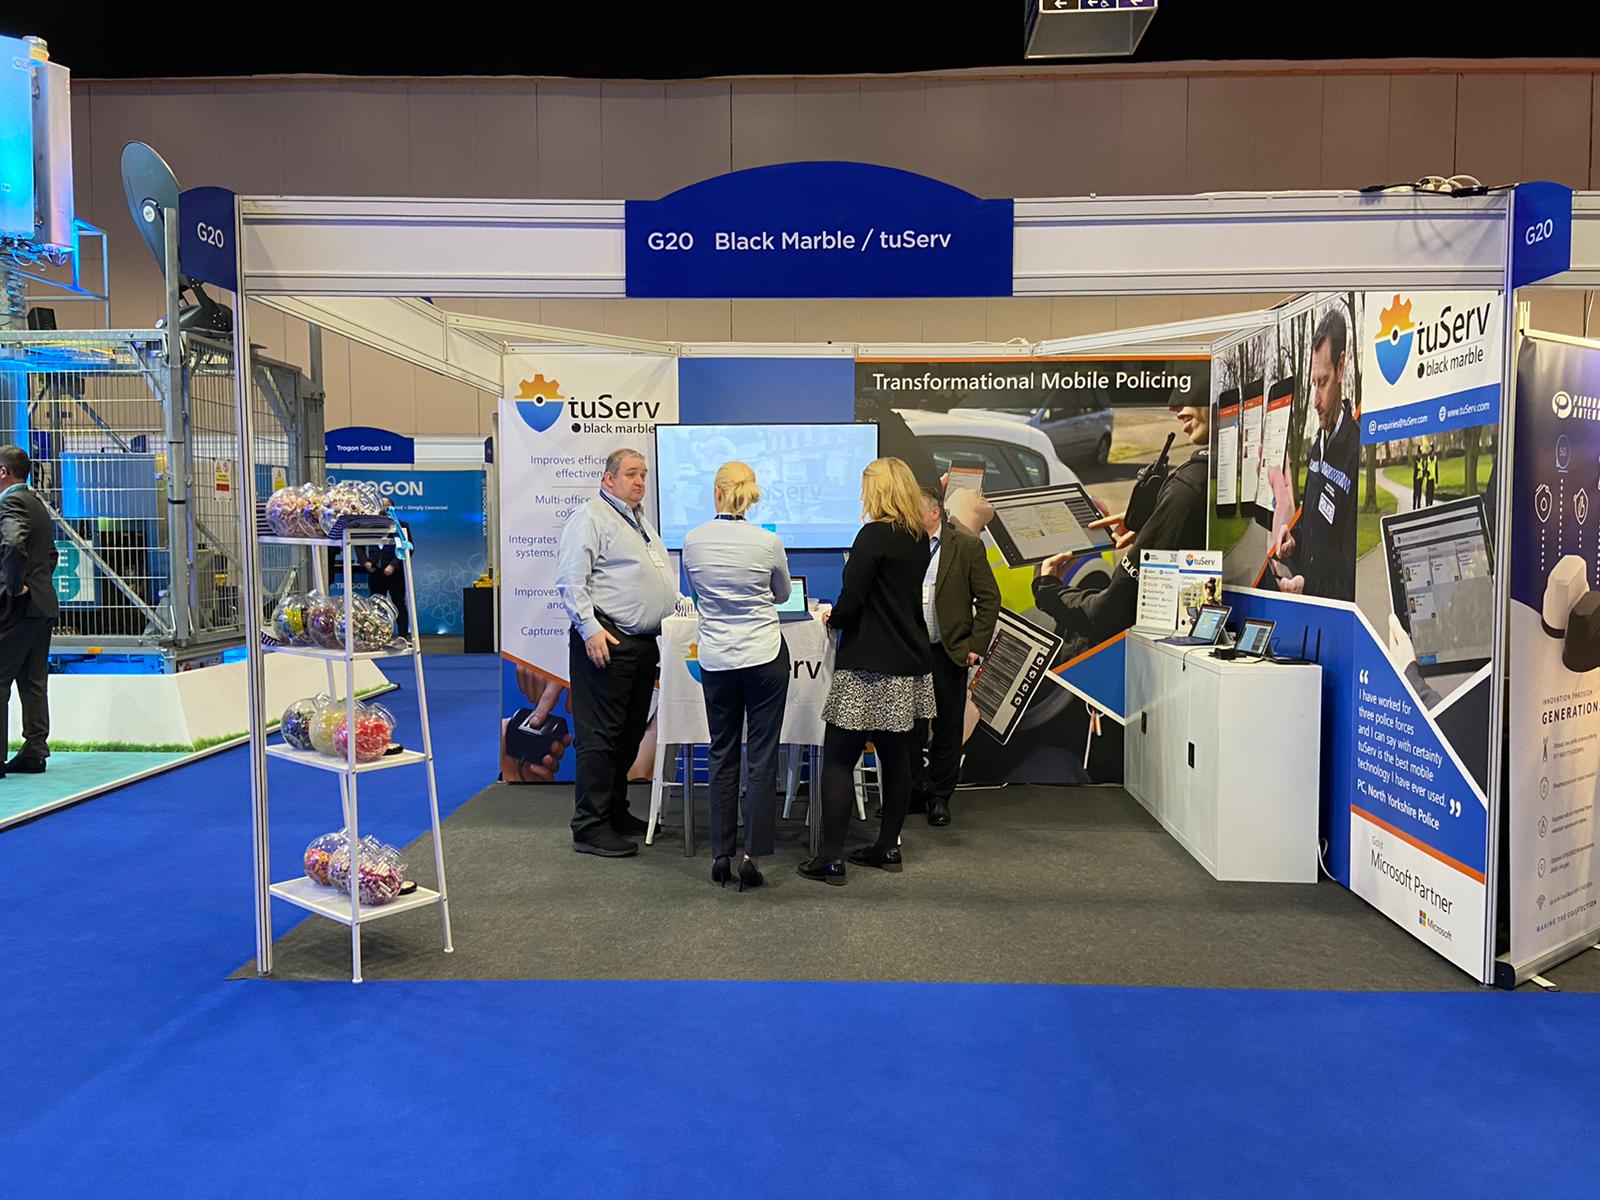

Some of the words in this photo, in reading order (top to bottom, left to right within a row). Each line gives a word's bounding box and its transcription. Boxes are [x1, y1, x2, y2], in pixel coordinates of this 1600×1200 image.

[197, 221, 224, 248] G20
[647, 231, 694, 251] G20
[715, 231, 775, 251] Black
[781, 230, 856, 251] Marble
[879, 230, 952, 250] tuServ
[1525, 218, 1553, 246] G20
[1416, 302, 1491, 356] tuServ
[1426, 356, 1449, 377] black
[1449, 345, 1484, 371] marble
[873, 372, 1035, 392] Transformational
[1041, 371, 1110, 391] Mobile
[1115, 371, 1192, 393] Policing
[567, 393, 661, 419] tuServ
[583, 422, 613, 434] black
[615, 422, 655, 434] marble
[336, 444, 359, 453] Trogon
[359, 444, 380, 453] Group
[380, 444, 392, 452] Ltd
[530, 455, 576, 467] Improves
[555, 468, 603, 479] effectiven
[508, 535, 558, 547] Integrates
[514, 587, 560, 599] Improves
[520, 626, 565, 638] Captures
[1362, 689, 1378, 705] have
[1378, 696, 1401, 712] worked
[1402, 700, 1412, 715] for
[1541, 701, 1600, 725] GENERATION
[1358, 705, 1375, 721] three
[1375, 712, 1394, 729] police
[1395, 716, 1415, 736] forces
[1358, 724, 1370, 737] and
[1374, 731, 1386, 744] can
[1386, 735, 1397, 750] say
[1397, 738, 1412, 754] with
[1412, 745, 1443, 769] certainty
[1358, 740, 1377, 757] tuServ
[1377, 747, 1383, 760] is
[1383, 749, 1395, 765] the
[1395, 753, 1409, 772] best
[1409, 762, 1434, 782] mobile
[1357, 757, 1391, 784] technology
[1395, 772, 1410, 791] have
[1411, 782, 1427, 797] ever
[1427, 790, 1447, 808] used.
[1367, 783, 1387, 804] North
[1387, 792, 1418, 819] Yorkshire
[1418, 808, 1440, 830] Police
[1371, 834, 1384, 850] Gold
[1370, 848, 1412, 891] Microsoft
[1413, 875, 1454, 915] Partner
[1427, 917, 1453, 942] Microsoft
